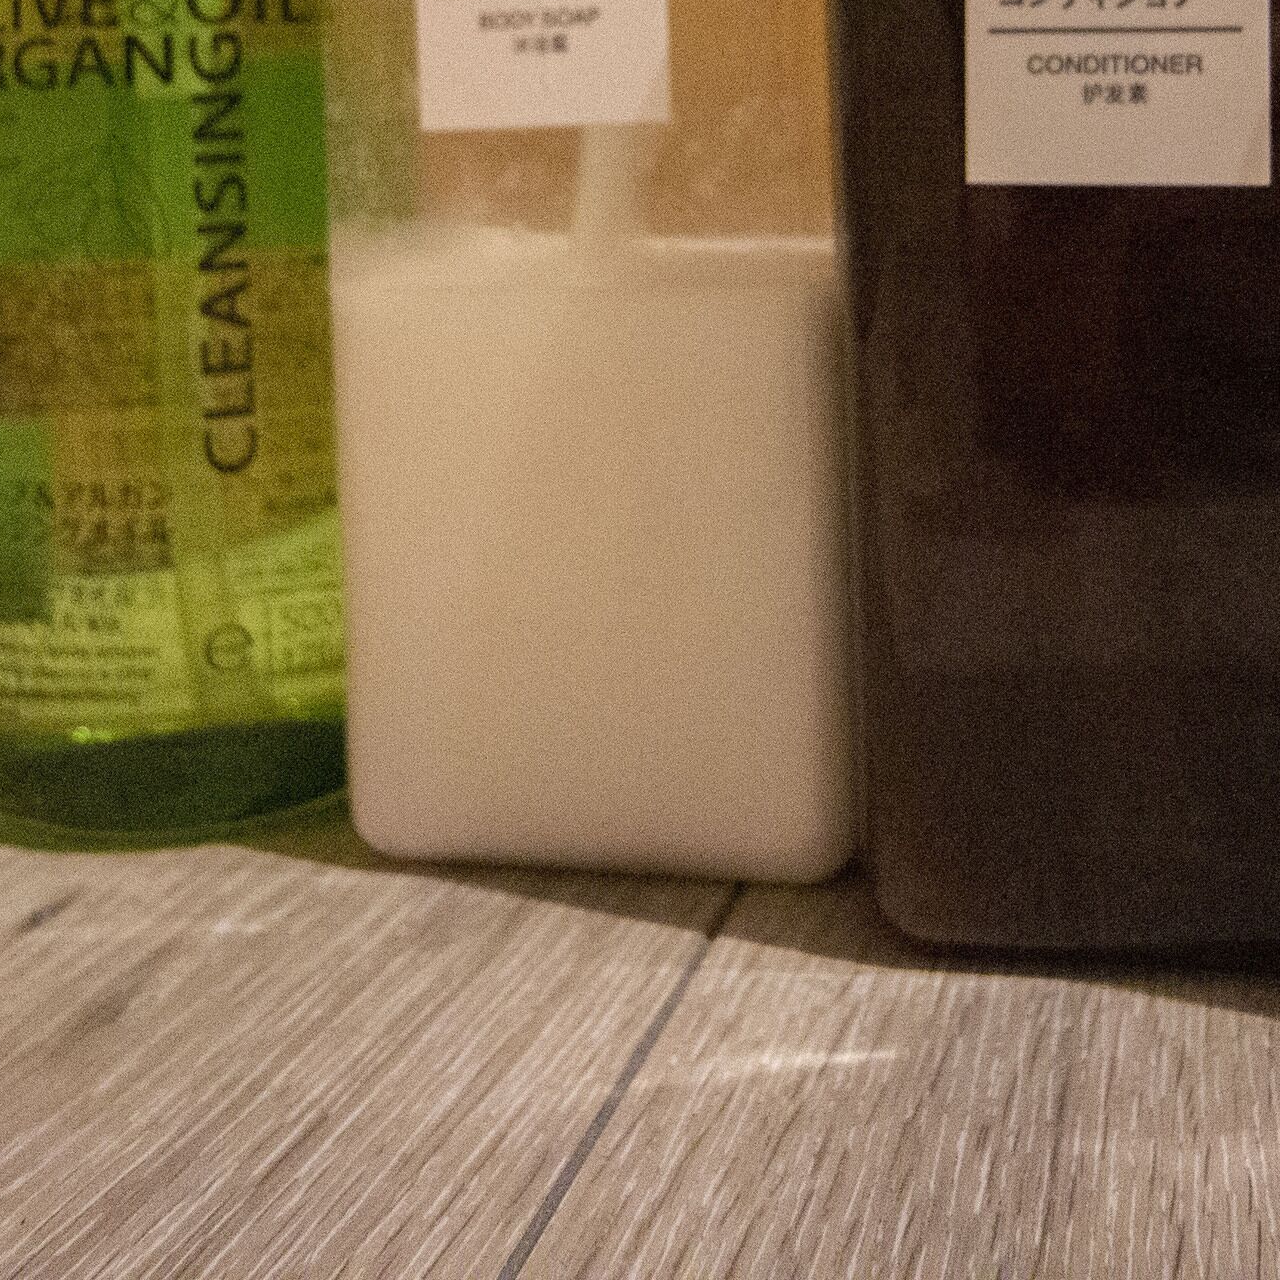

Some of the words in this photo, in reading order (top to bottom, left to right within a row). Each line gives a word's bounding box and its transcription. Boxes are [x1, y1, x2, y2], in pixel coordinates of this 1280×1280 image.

[478, 9, 535, 31] BODY
[1027, 53, 1203, 76] CONDITIONER
[189, 32, 257, 474] CLEANSING
